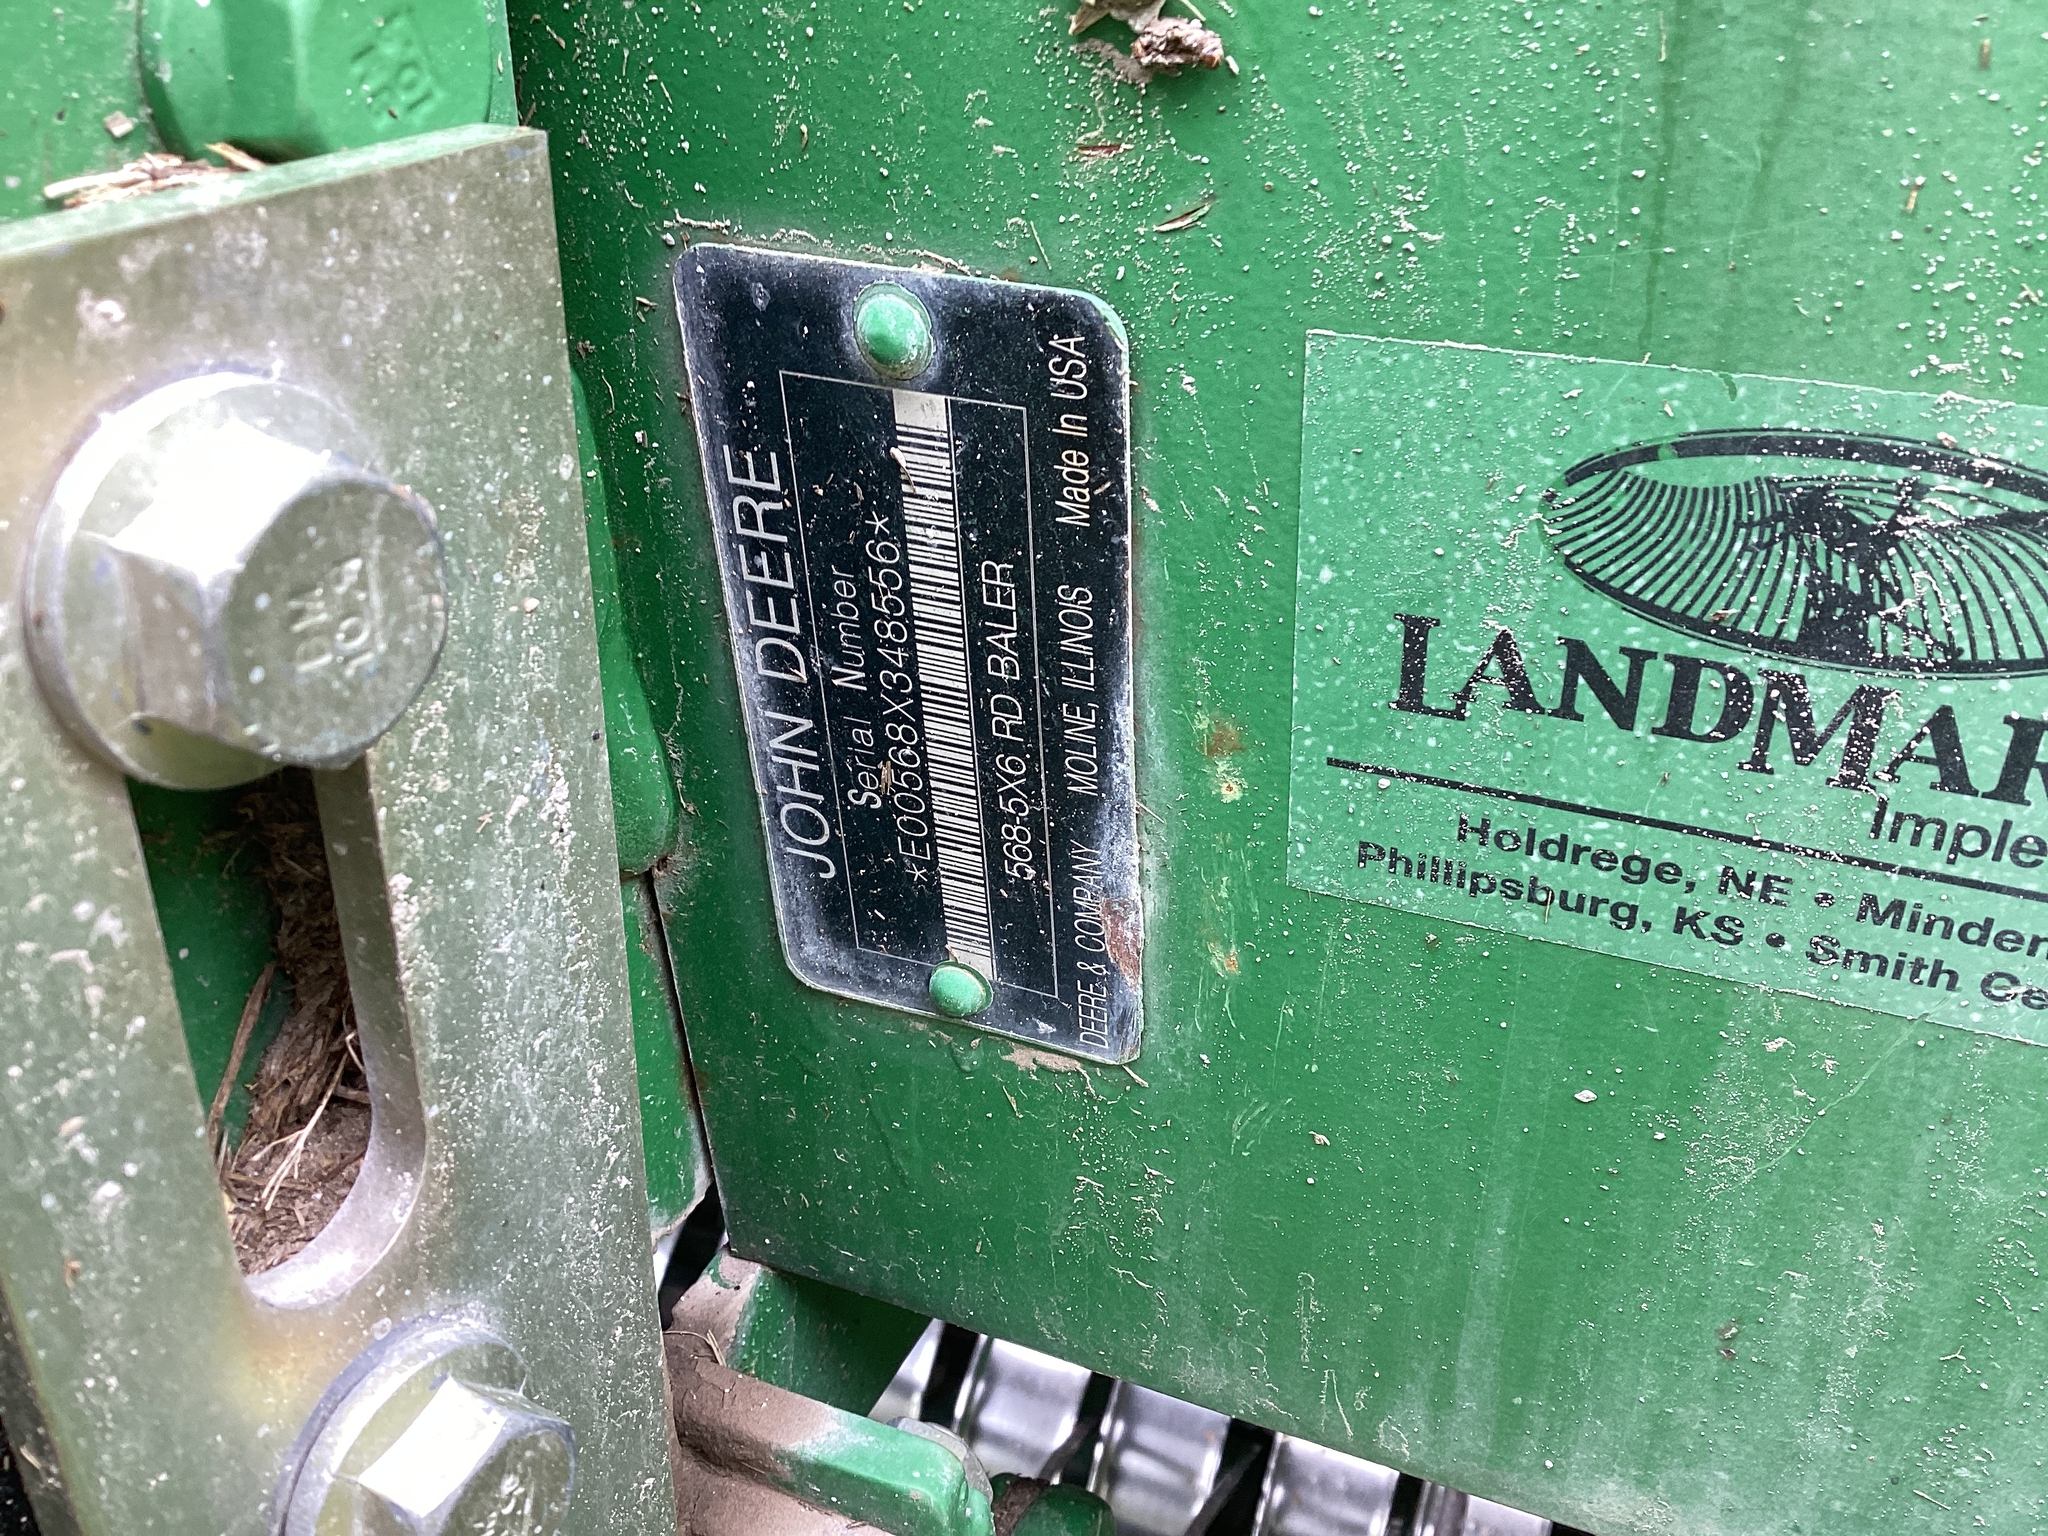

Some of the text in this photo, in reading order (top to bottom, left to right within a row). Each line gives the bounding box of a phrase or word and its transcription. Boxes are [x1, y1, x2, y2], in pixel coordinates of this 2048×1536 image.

[723, 444, 836, 879] JOHN DEERE
[830, 564, 882, 810] Serial Number
[980, 559, 1034, 881] 568-5X6 RD BALER
[1047, 334, 1110, 1049] DEERE & COMPANY MOLINE, ILLINOIS Made In USA
[1356, 839, 1652, 934] Phillipsburg,
[1672, 905, 1746, 948] KS
[1804, 933, 1960, 992] Smith
[1457, 812, 1698, 895] Holdrege,
[1717, 864, 1795, 908] NE
[1858, 795, 2048, 868] Imple
